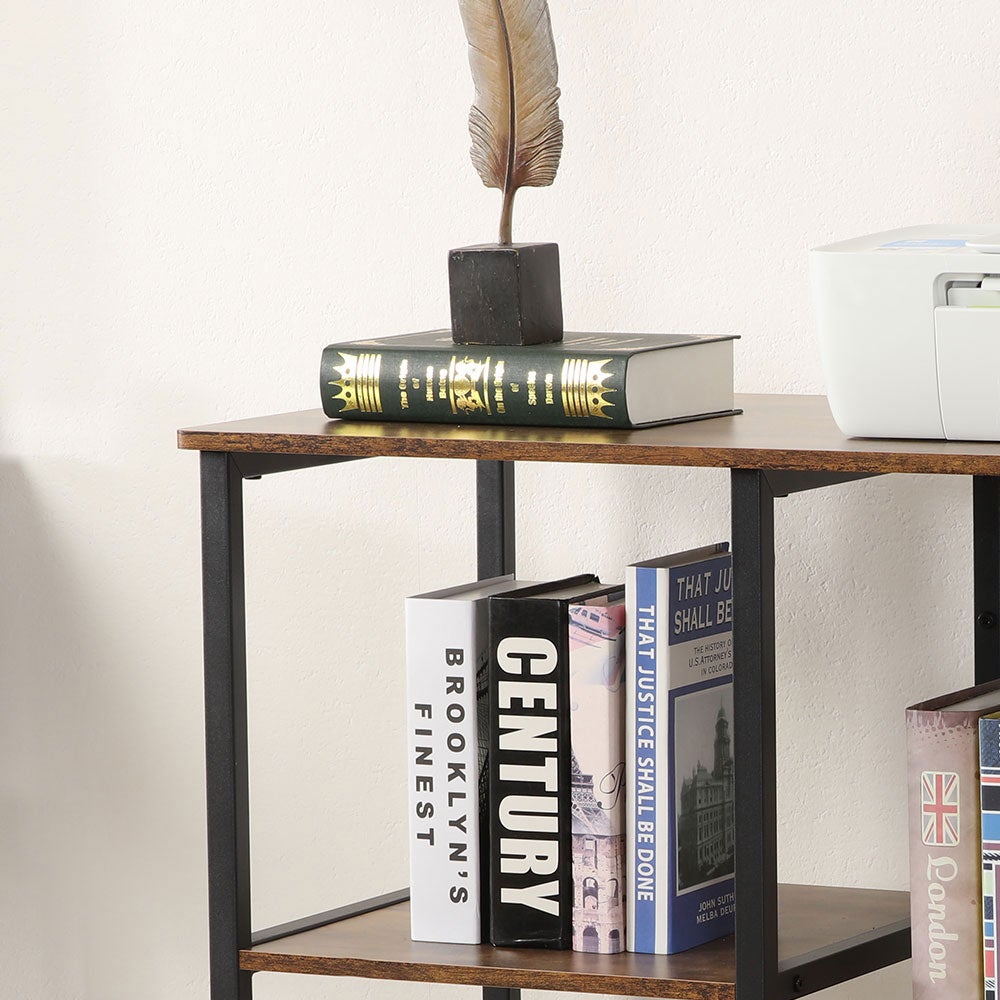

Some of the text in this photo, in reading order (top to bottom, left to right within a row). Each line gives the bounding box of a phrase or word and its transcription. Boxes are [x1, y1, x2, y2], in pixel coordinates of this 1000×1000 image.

[674, 598, 733, 634] SHALL BE
[677, 571, 712, 601] THAT
[693, 644, 704, 655] THE
[705, 641, 726, 653] HISTORY
[414, 703, 435, 847] FINEST
[445, 647, 469, 905] BROOKLYN'S
[496, 636, 560, 917] CENTURY
[637, 605, 656, 902] THAT JUSTICE SHALL BE DONE
[696, 910, 718, 924] MELBA
[699, 898, 716, 912] JOHN
[927, 853, 959, 984] London
